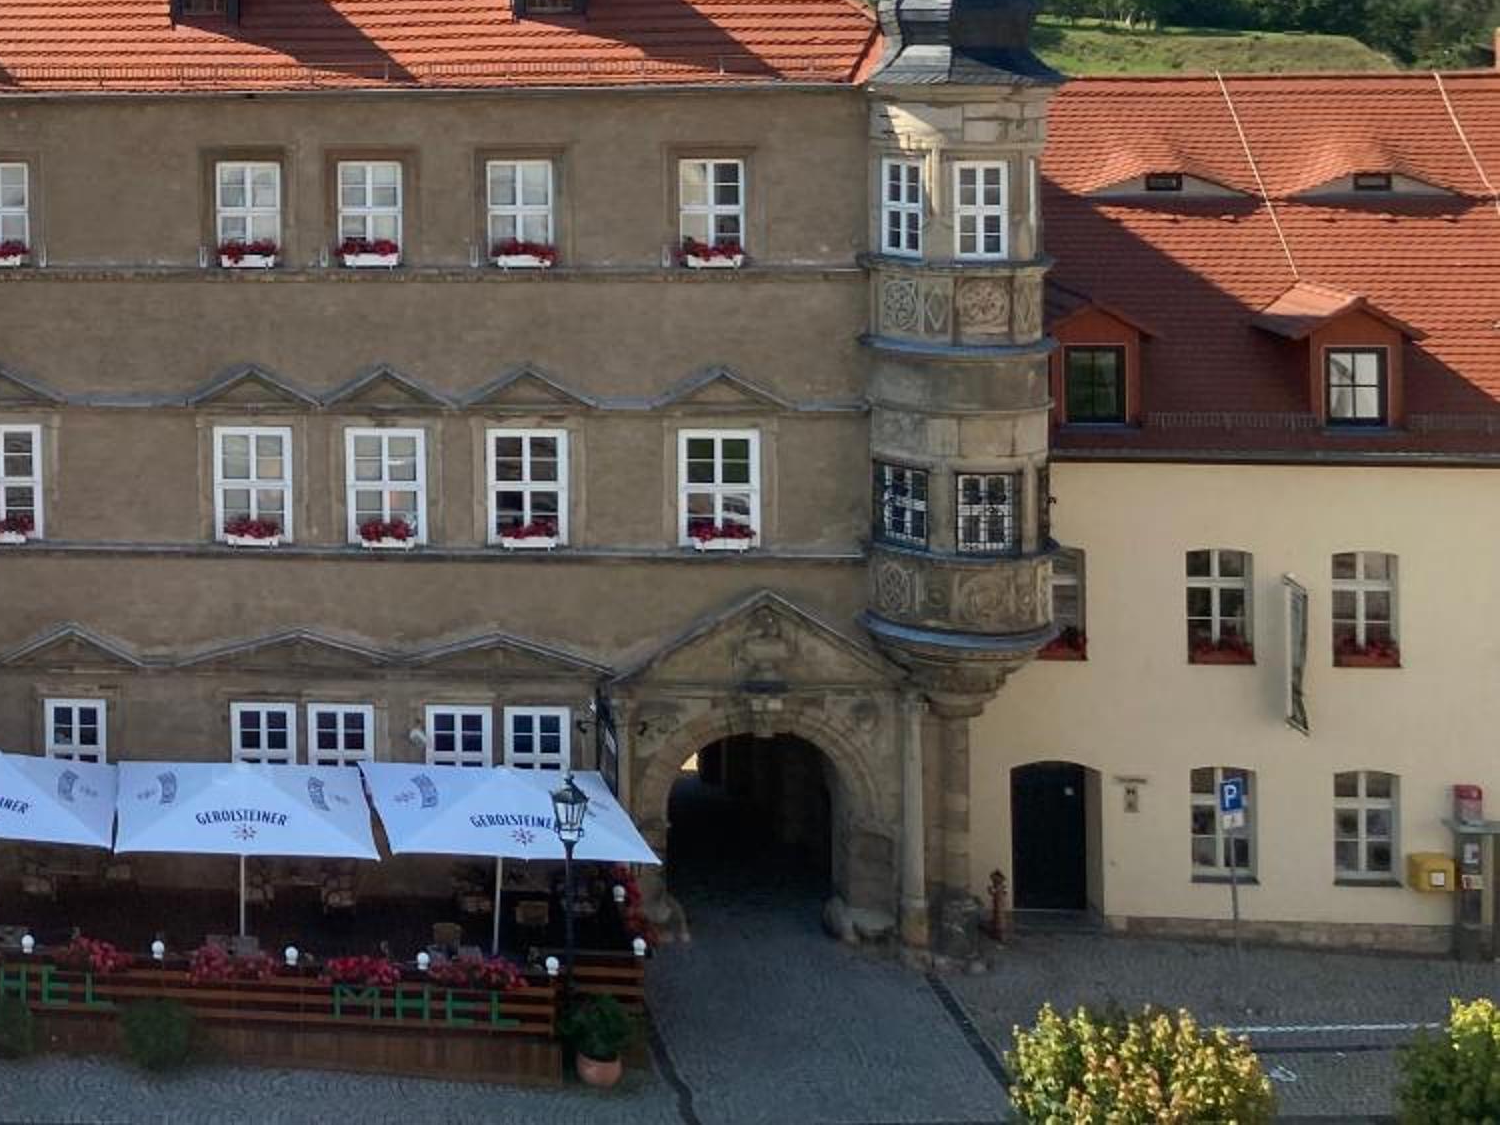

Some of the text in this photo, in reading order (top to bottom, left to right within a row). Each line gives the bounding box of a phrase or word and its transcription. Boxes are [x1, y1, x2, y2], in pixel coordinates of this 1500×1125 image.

[1223, 784, 1237, 808] P
[195, 810, 288, 826] GEROLSTEINER
[469, 813, 552, 829] GEROLSTEINE
